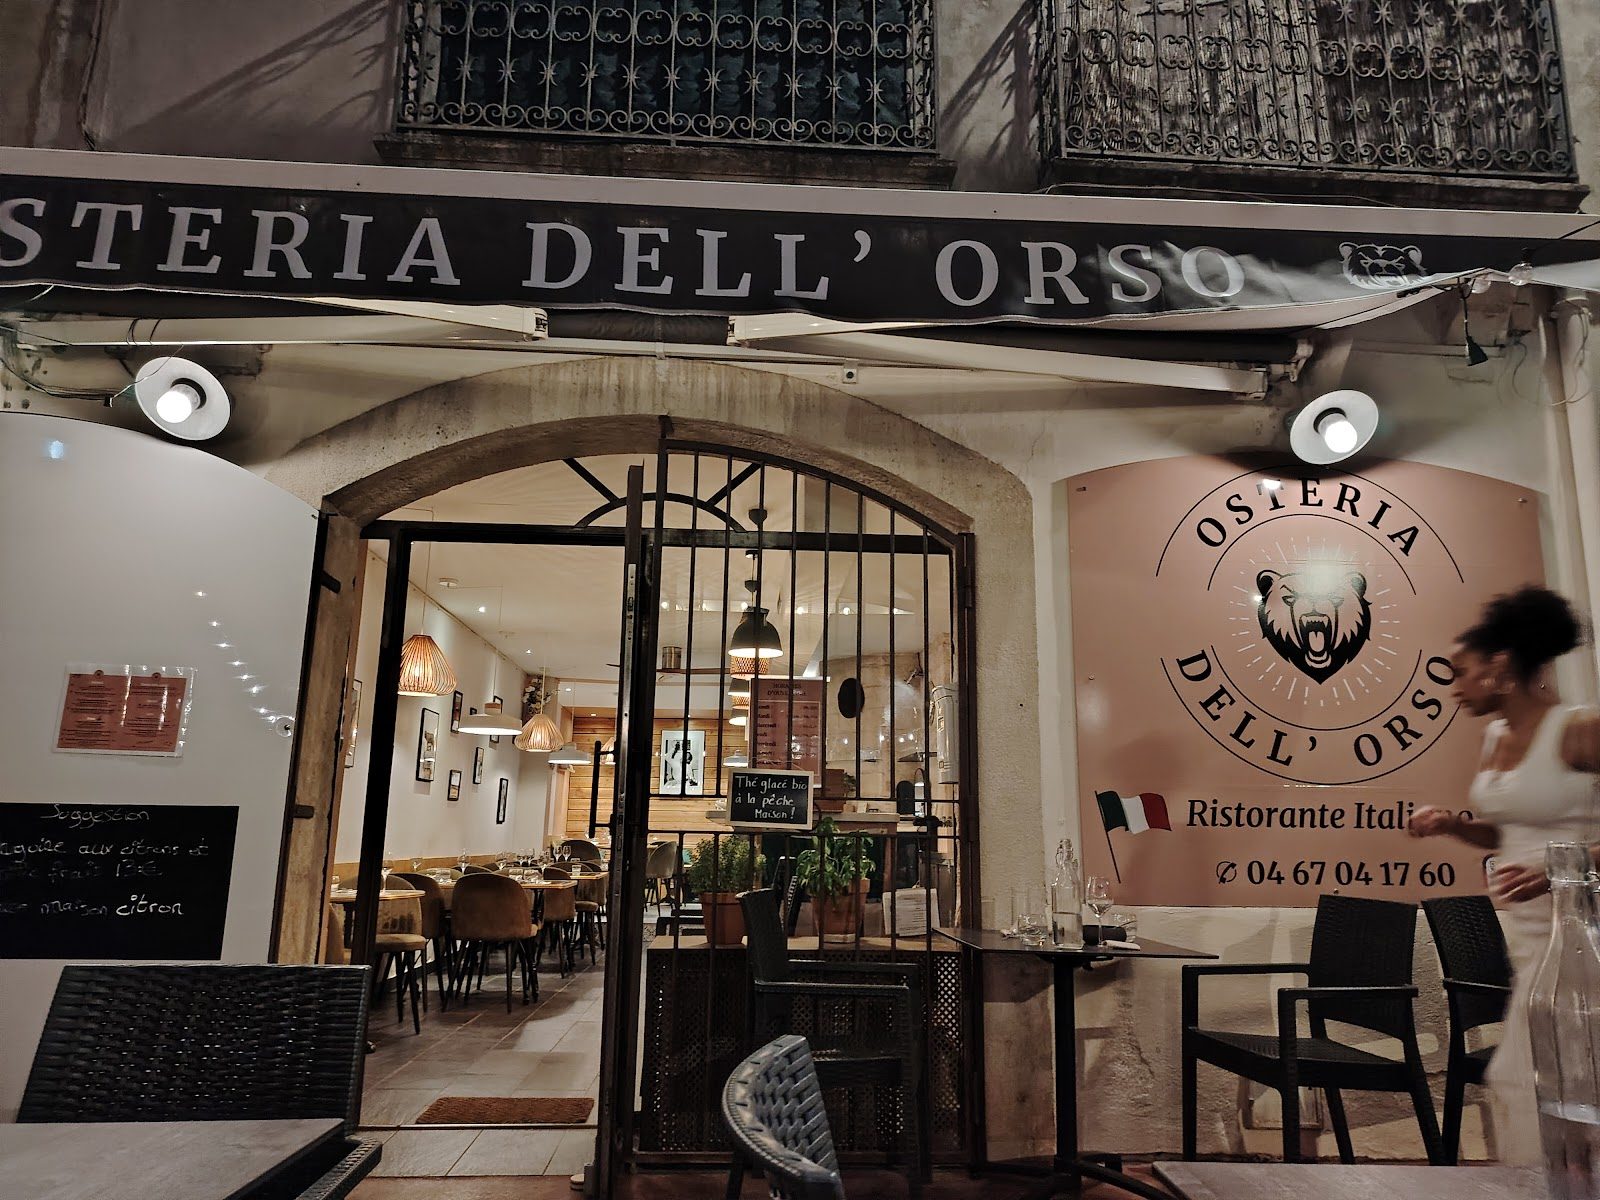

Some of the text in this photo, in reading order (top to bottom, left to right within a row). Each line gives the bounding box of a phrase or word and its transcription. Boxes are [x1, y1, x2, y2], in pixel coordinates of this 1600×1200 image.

[0, 197, 1246, 307] STERIA DELL' ORSO
[1196, 477, 1420, 557] OSTERIA
[1176, 649, 1456, 767] DELL' ORSO
[735, 775, 808, 794] Thé glacé bio
[747, 793, 756, 804] la
[762, 794, 794, 808] pêche
[1186, 799, 1345, 829] Ristorante
[40, 803, 150, 829] Suggestion
[1247, 860, 1456, 887] 04 67 04 17 60
[116, 894, 184, 916] citron
